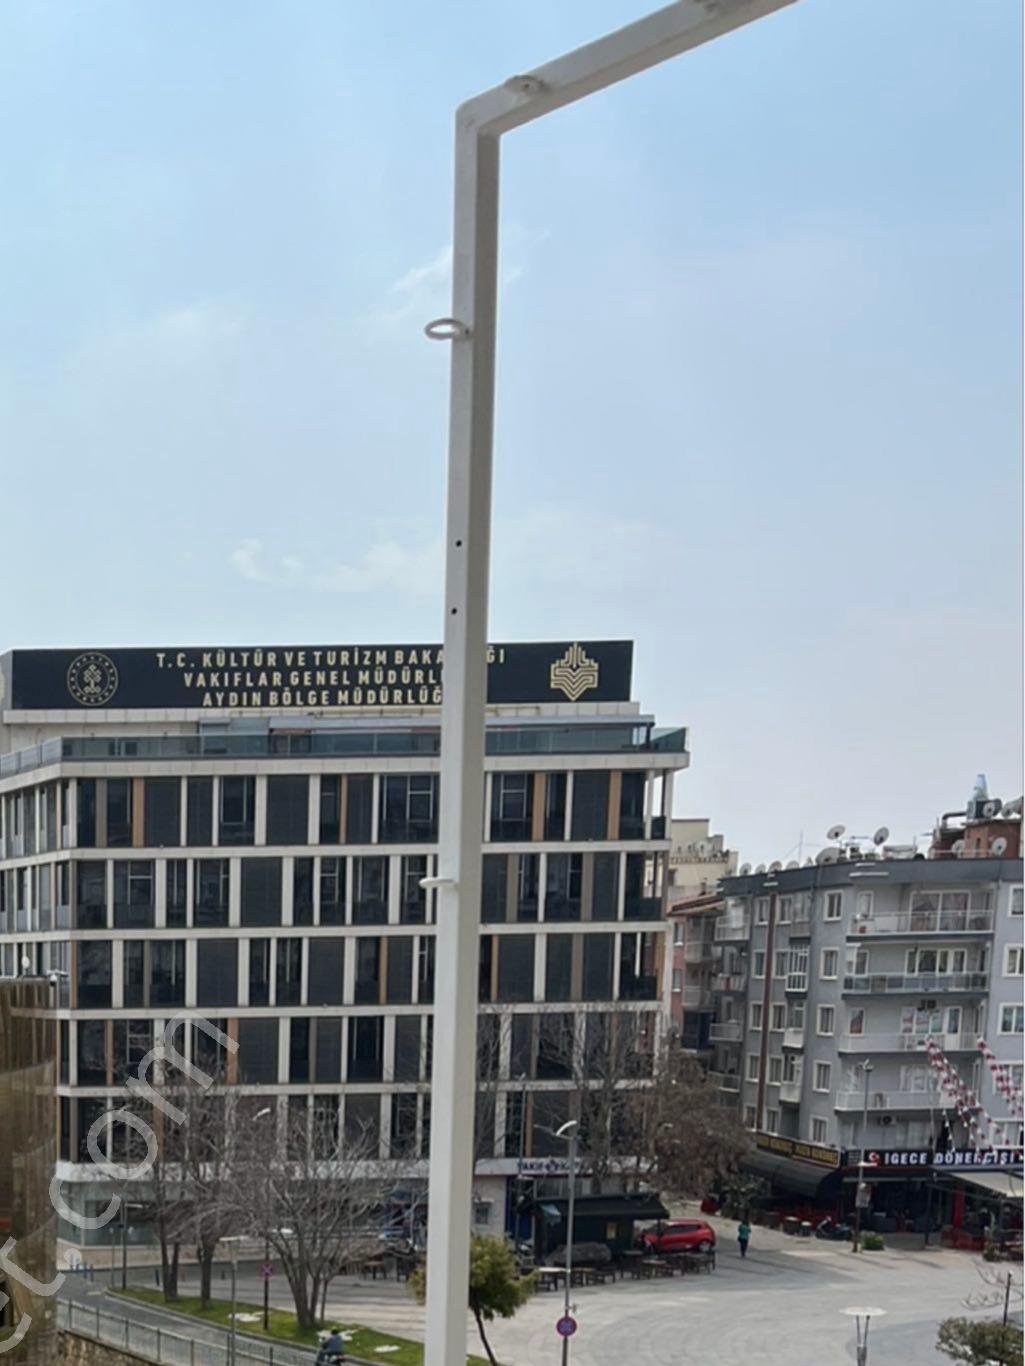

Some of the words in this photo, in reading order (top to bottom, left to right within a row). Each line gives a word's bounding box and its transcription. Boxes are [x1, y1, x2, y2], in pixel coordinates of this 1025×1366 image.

[156, 652, 195, 668] T.C.
[202, 649, 277, 668] KÜLTÜR
[284, 651, 306, 667] VE
[313, 647, 387, 667] TURİZM
[394, 646, 505, 665] BAKAĞI
[183, 671, 282, 688] VAKIFLAR
[289, 670, 351, 687] GENEL
[202, 691, 262, 707] AYDIN
[269, 687, 330, 706] BÖLGE
[338, 685, 444, 705] MÜDÜRLÜĞ
